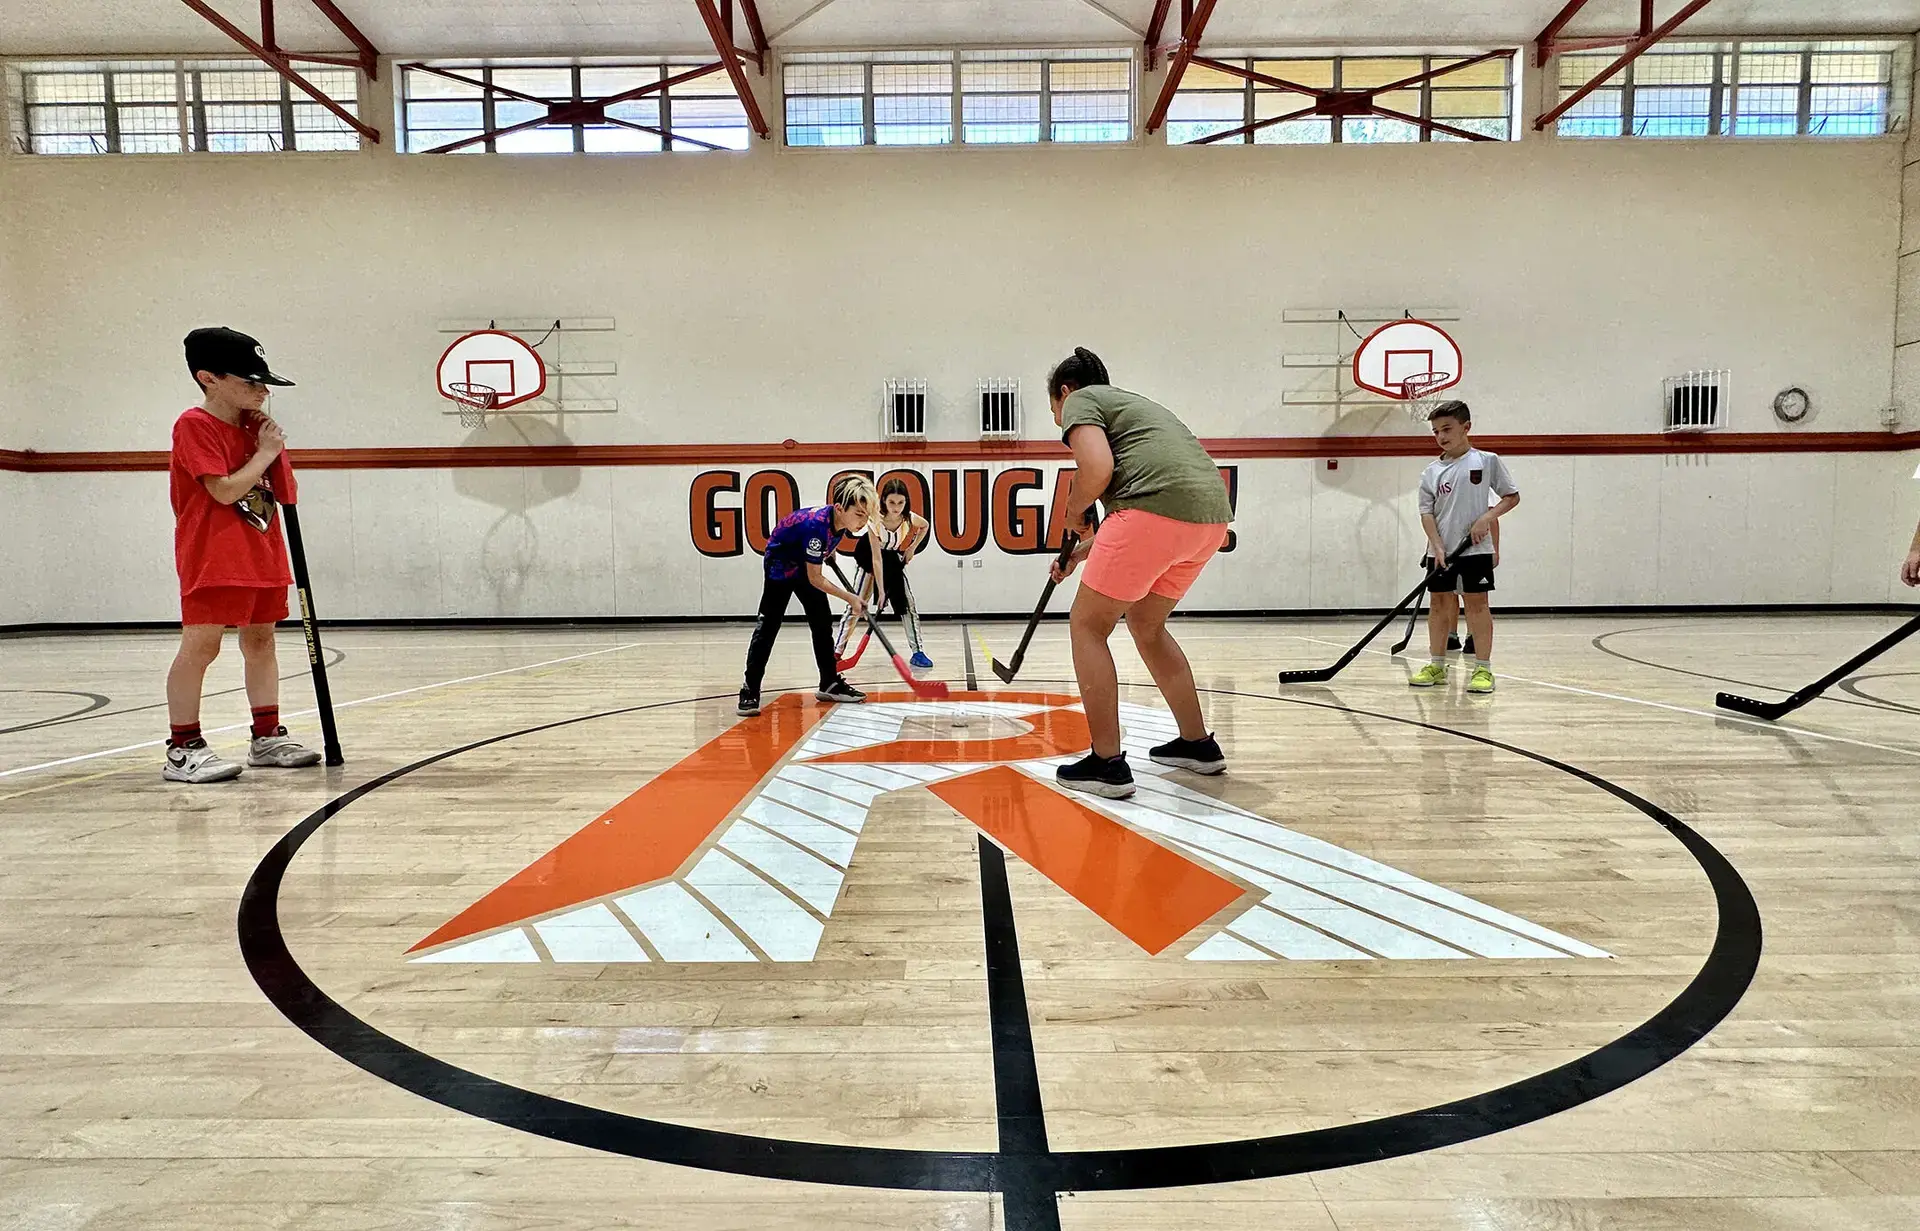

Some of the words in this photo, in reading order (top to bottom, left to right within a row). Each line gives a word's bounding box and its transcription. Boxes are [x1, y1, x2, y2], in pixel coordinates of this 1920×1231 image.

[689, 469, 801, 557] GO
[826, 466, 1238, 557] OUGA
[304, 619, 313, 641] SHAFT
